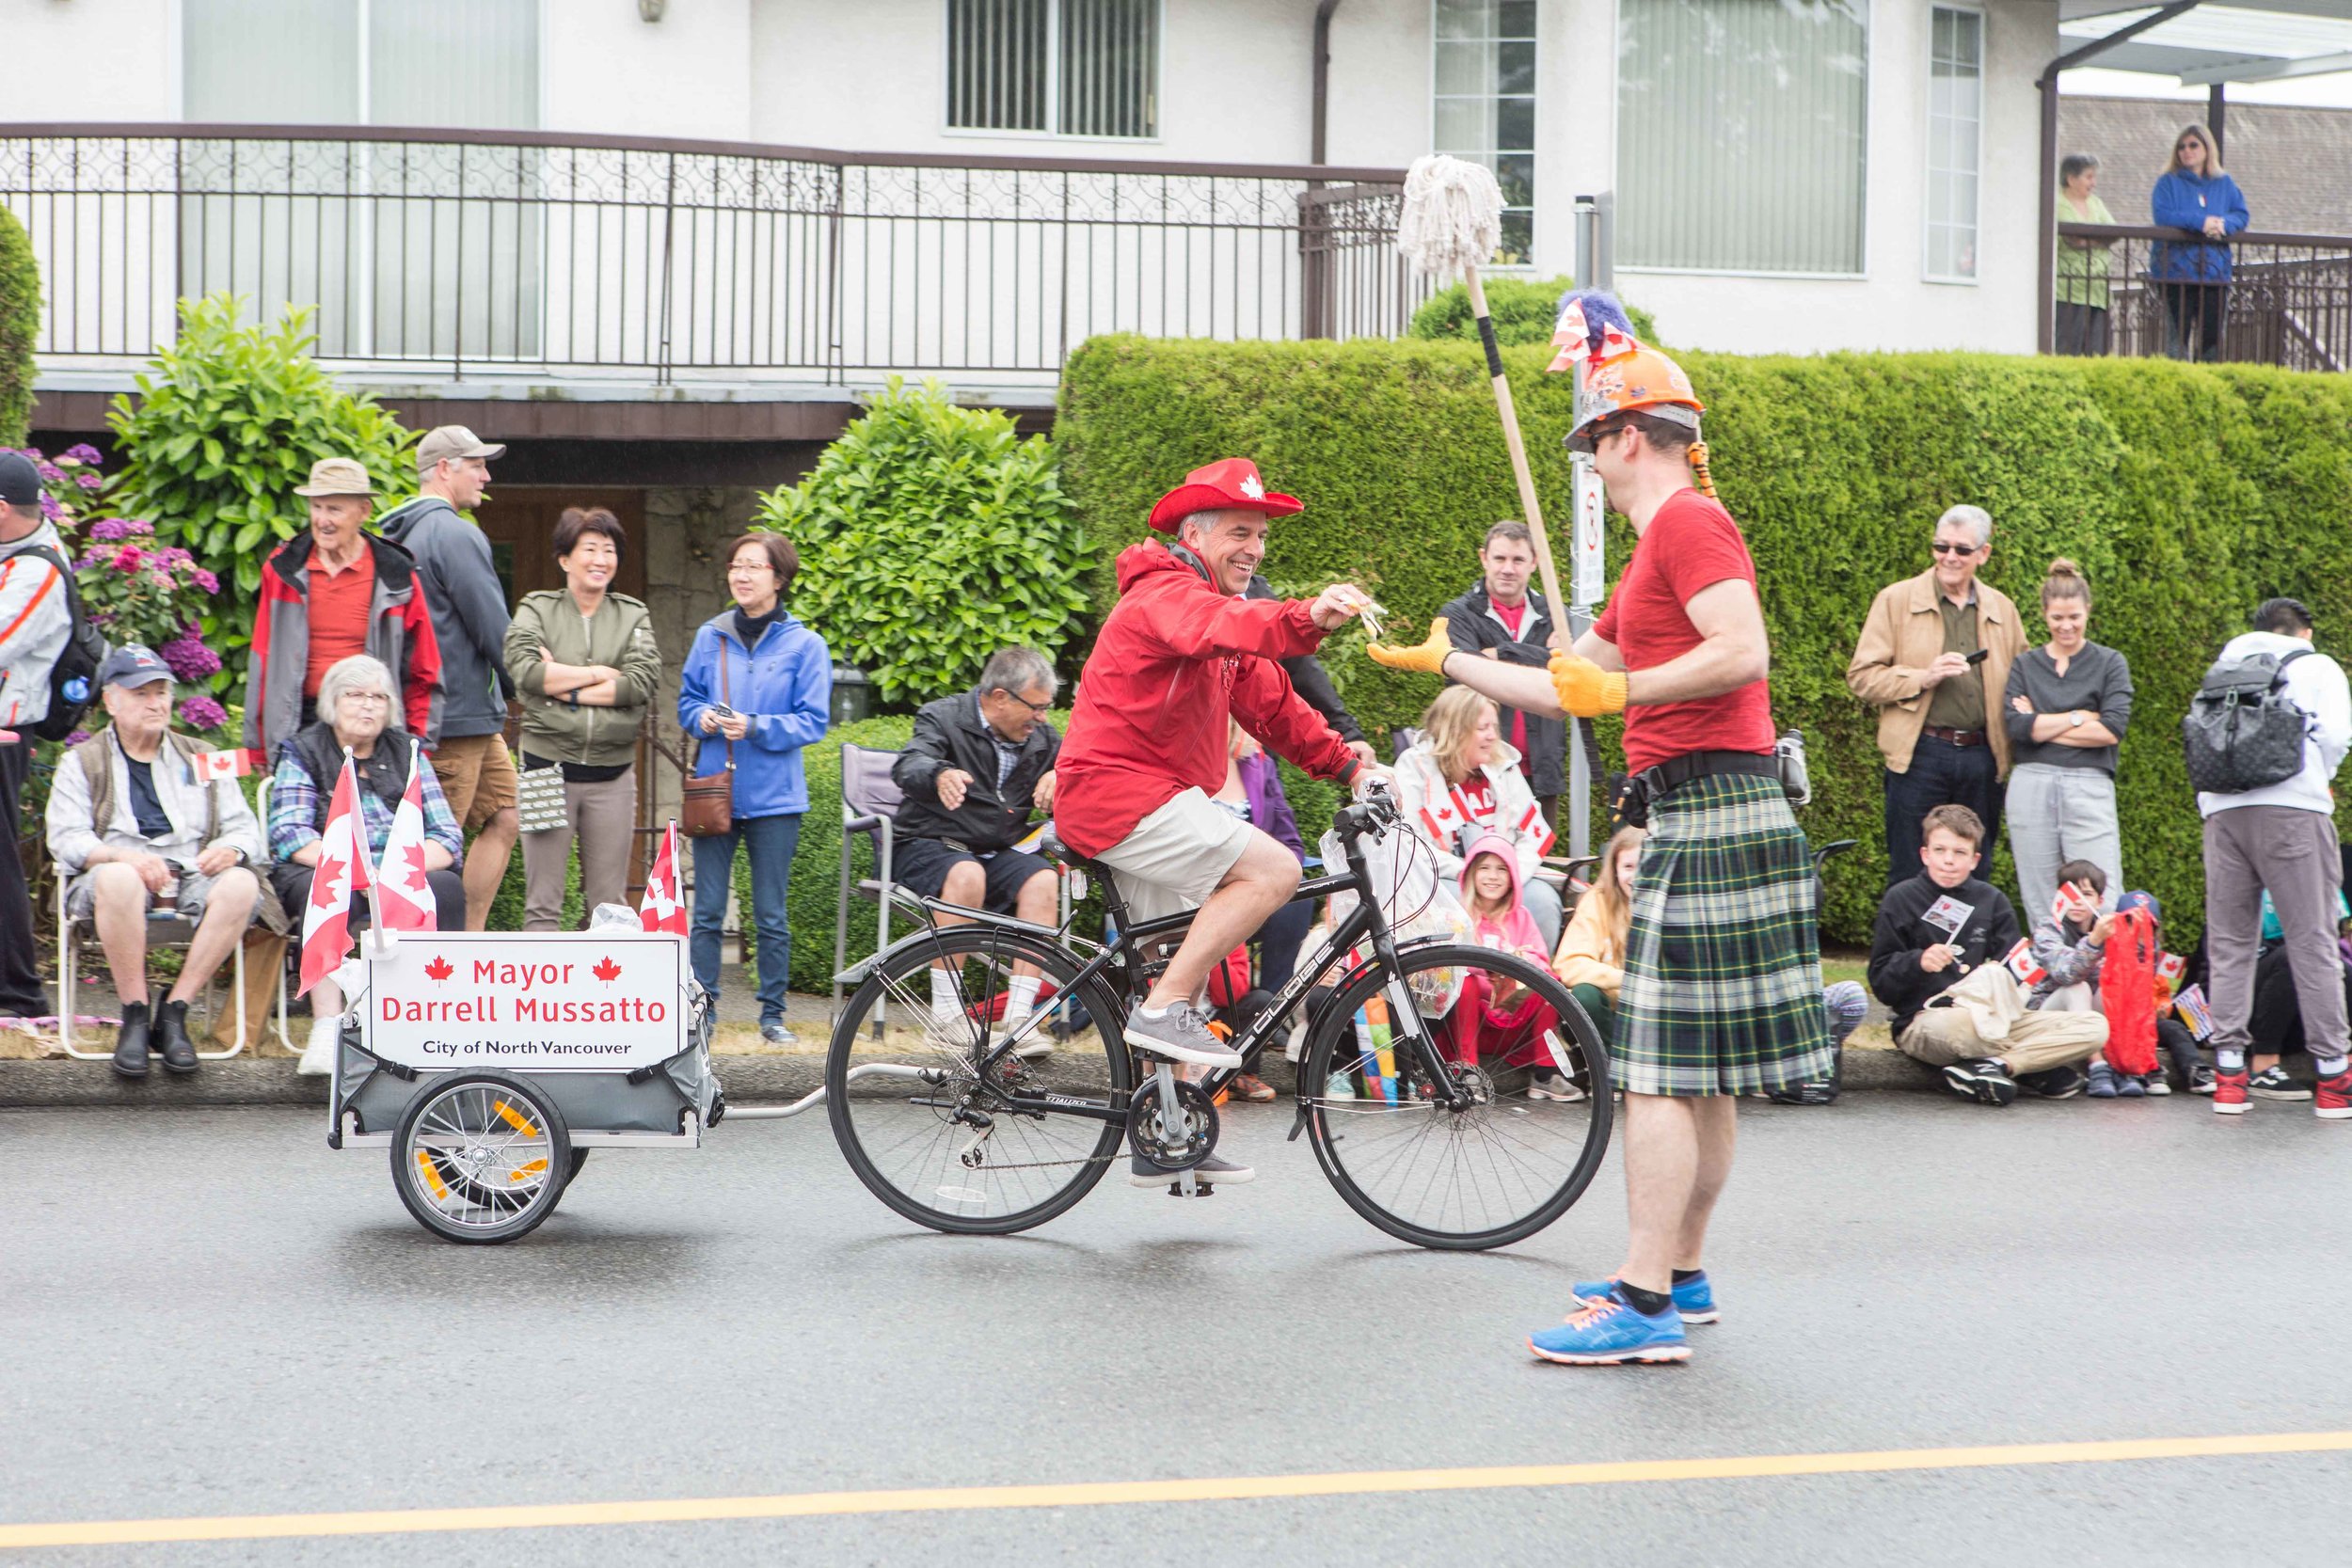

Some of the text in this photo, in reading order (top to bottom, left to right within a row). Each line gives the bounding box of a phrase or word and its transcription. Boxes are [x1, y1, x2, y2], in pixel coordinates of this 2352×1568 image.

[473, 959, 575, 991] Mayor
[1253, 942, 1335, 1035] GLOBE
[382, 996, 666, 1022] Darrell Mussatto
[422, 1039, 632, 1057] City of North Vancouver
